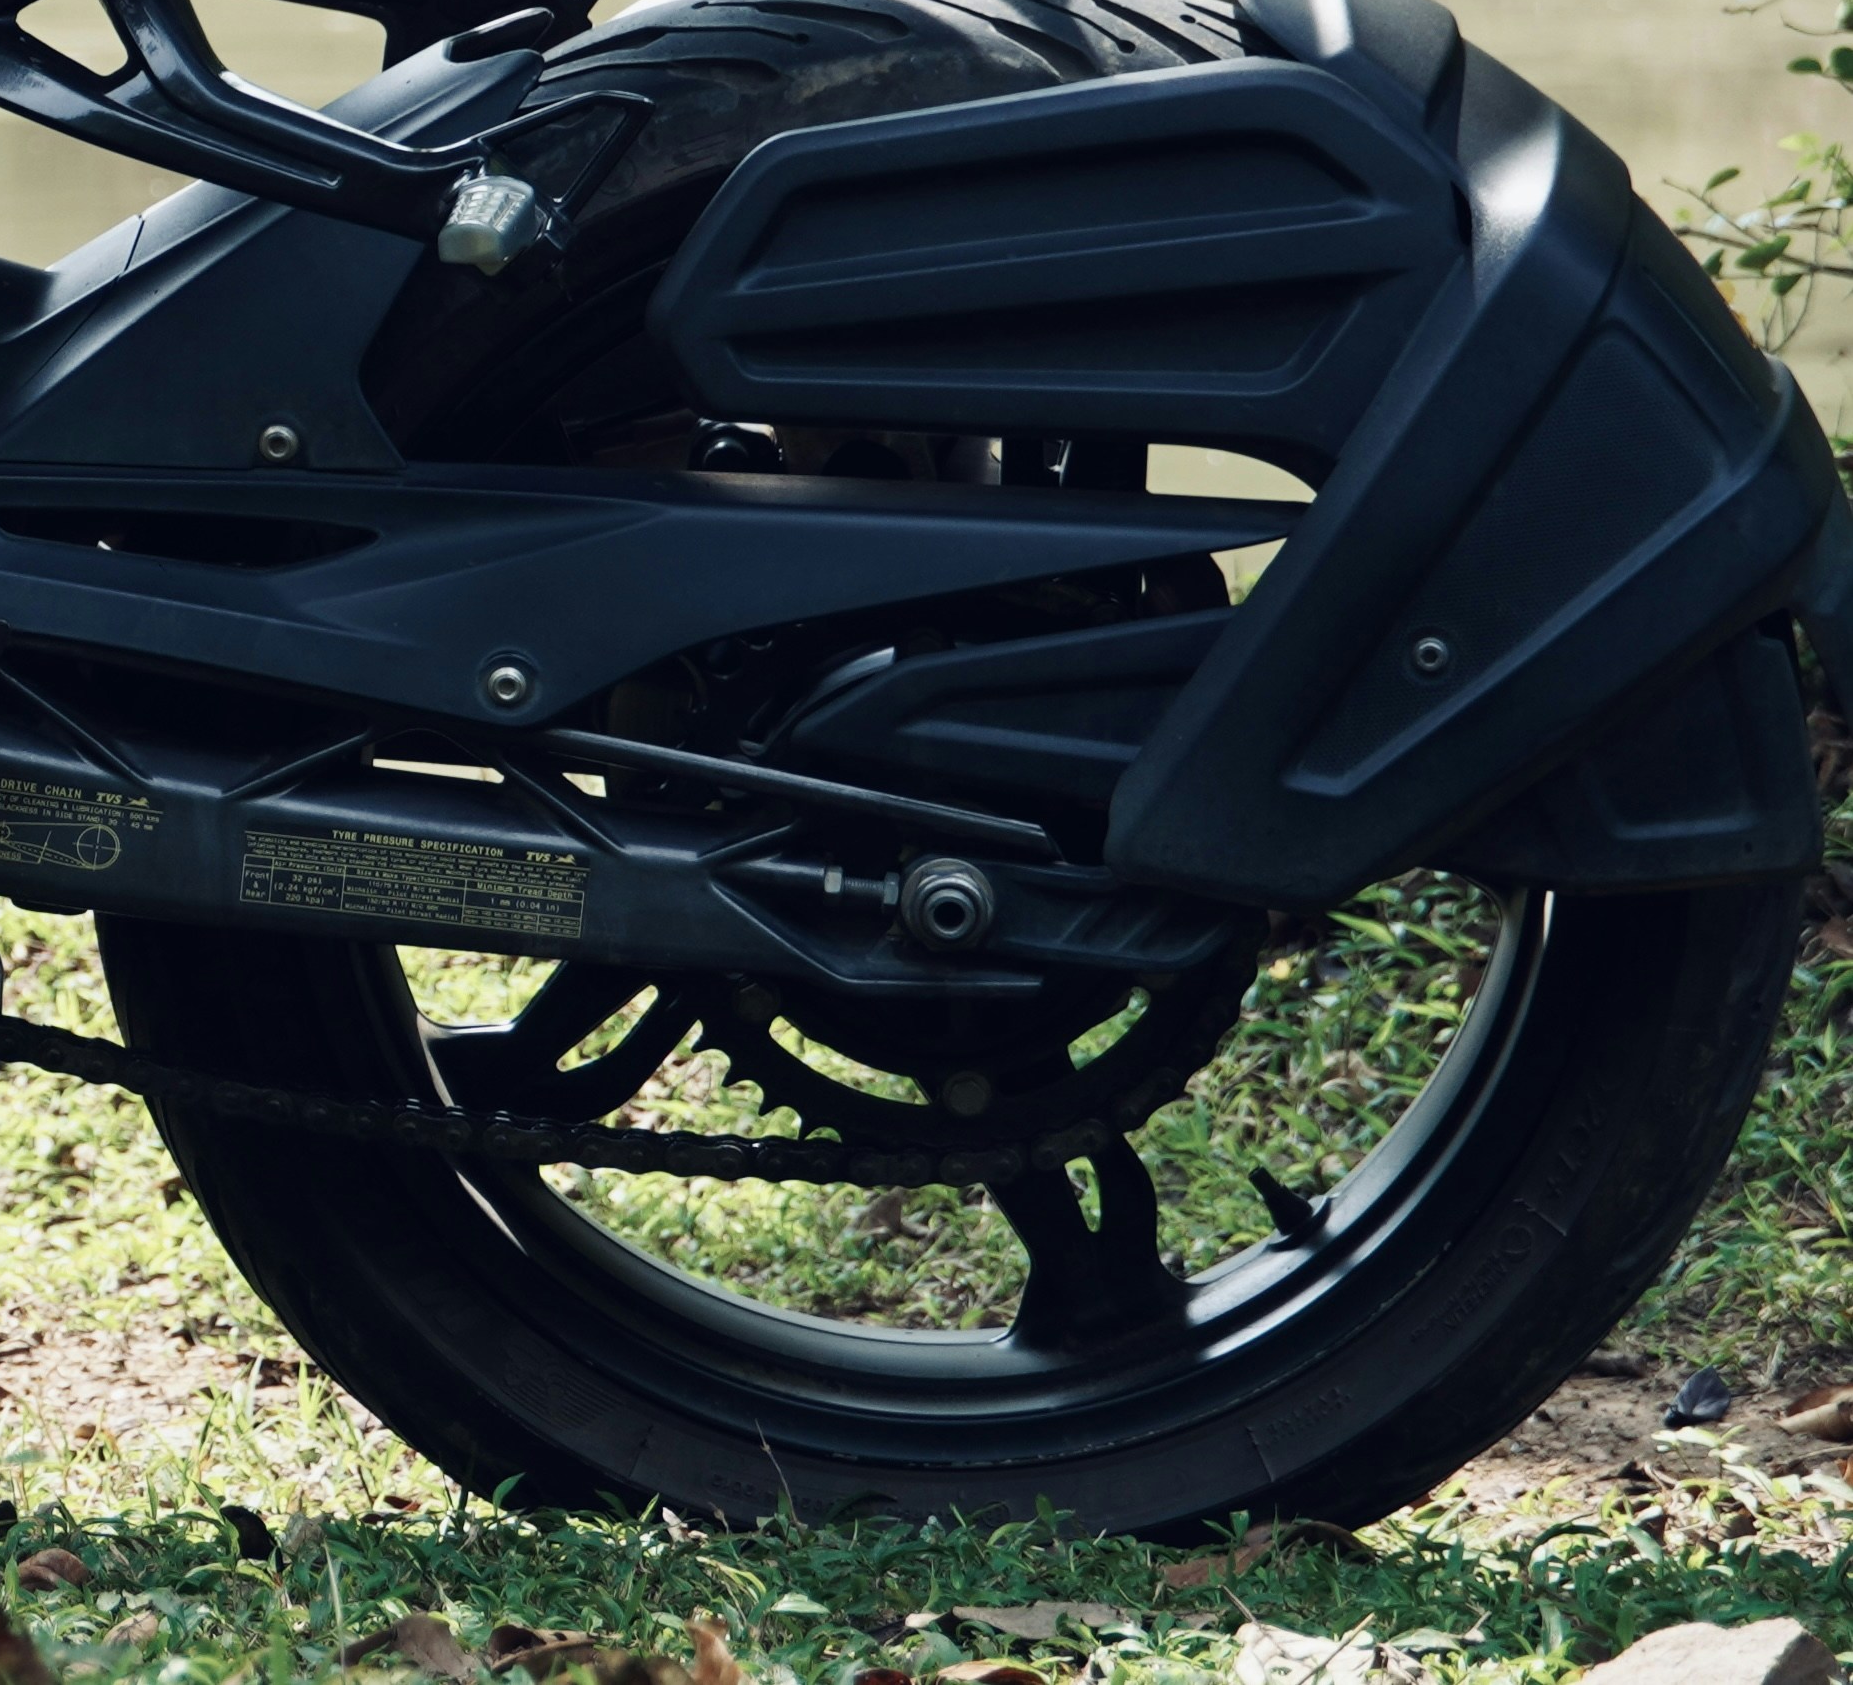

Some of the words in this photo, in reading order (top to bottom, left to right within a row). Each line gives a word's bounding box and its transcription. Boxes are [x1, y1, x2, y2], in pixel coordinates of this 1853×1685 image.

[0, 777, 38, 793] DRIVE
[44, 785, 82, 800] CHAIN
[95, 791, 123, 805] TVS
[331, 829, 357, 841] TYRE
[363, 833, 414, 848] PRESSURE
[420, 839, 504, 857] SPECIFICATION
[526, 850, 552, 862] TVS
